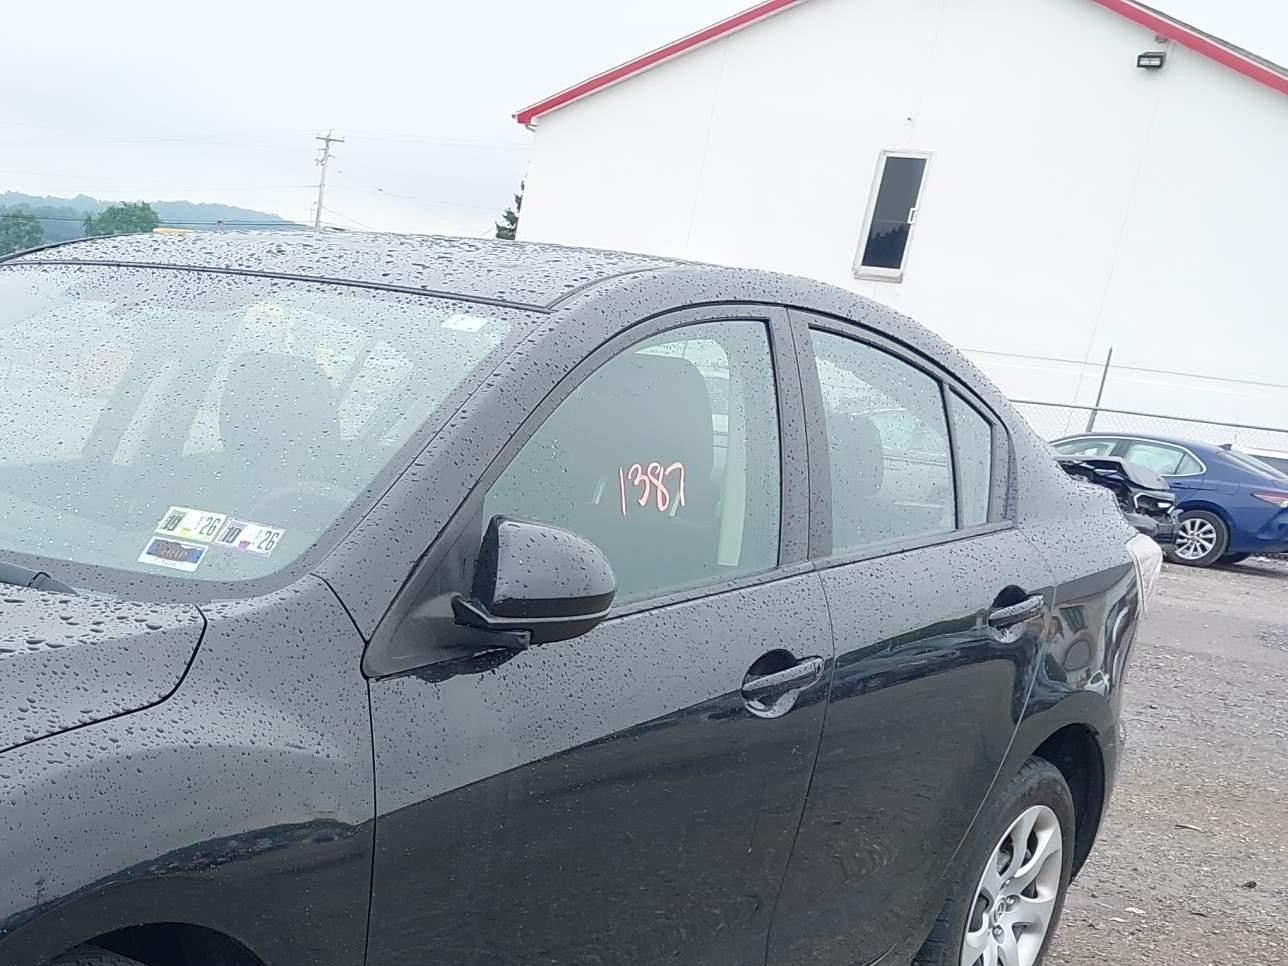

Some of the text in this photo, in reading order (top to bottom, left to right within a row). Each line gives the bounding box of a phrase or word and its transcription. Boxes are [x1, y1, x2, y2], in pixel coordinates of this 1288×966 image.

[618, 462, 685, 516] 1387
[199, 516, 221, 536] 26
[257, 530, 280, 551] 26
